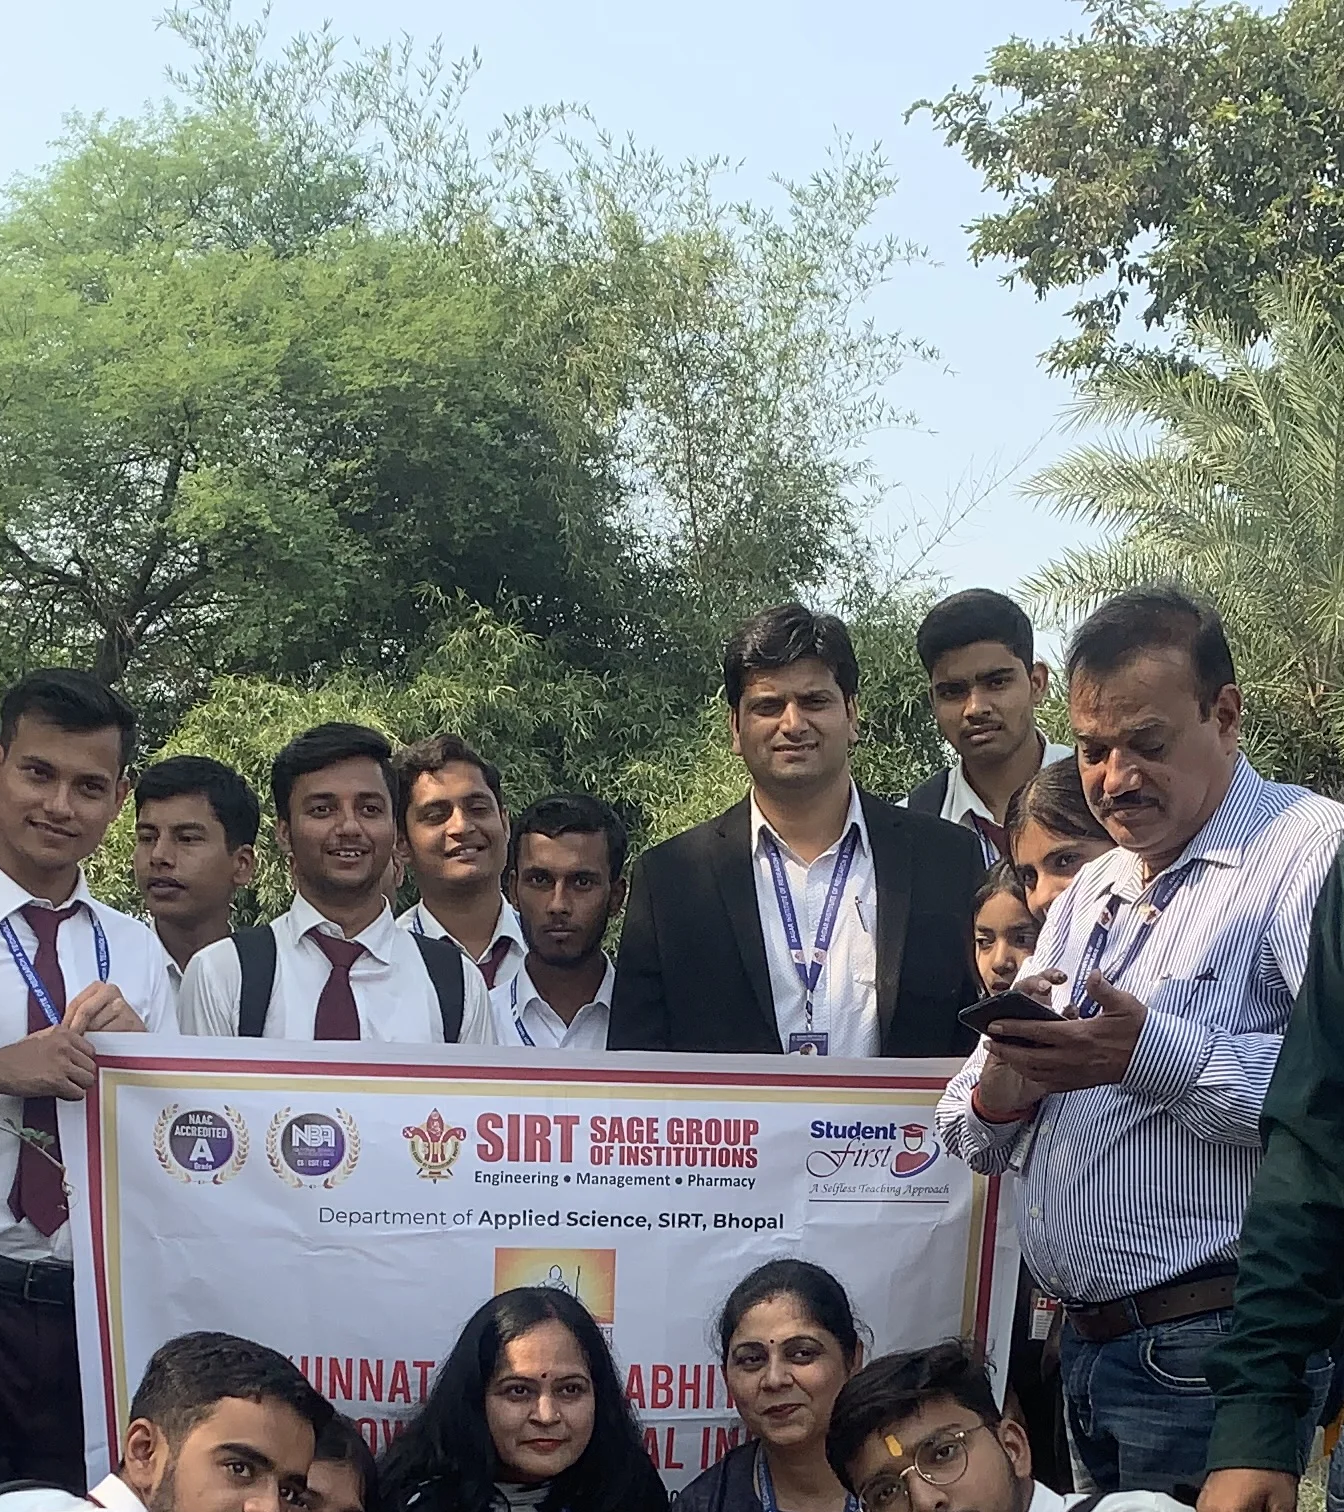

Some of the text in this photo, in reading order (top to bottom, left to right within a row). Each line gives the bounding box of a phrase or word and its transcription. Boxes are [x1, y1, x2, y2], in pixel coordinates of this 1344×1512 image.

[188, 1114, 213, 1125] NAAC
[590, 1116, 759, 1146] SAGE GROUP
[810, 1120, 897, 1140] Student
[174, 1124, 228, 1139] ACCREDITED
[291, 1124, 335, 1147] NBA
[476, 1112, 580, 1163] SIRT
[189, 1138, 215, 1162] A
[590, 1145, 758, 1169] OF INSTITUTIONS
[474, 1171, 756, 1190] Engineering Management Pharmacy
[821, 1182, 856, 1196] Selfless
[858, 1184, 901, 1196] Teaching
[903, 1183, 950, 1197] Approach
[319, 1207, 784, 1232] Department of Applied Science, SIRT, Bhopal
